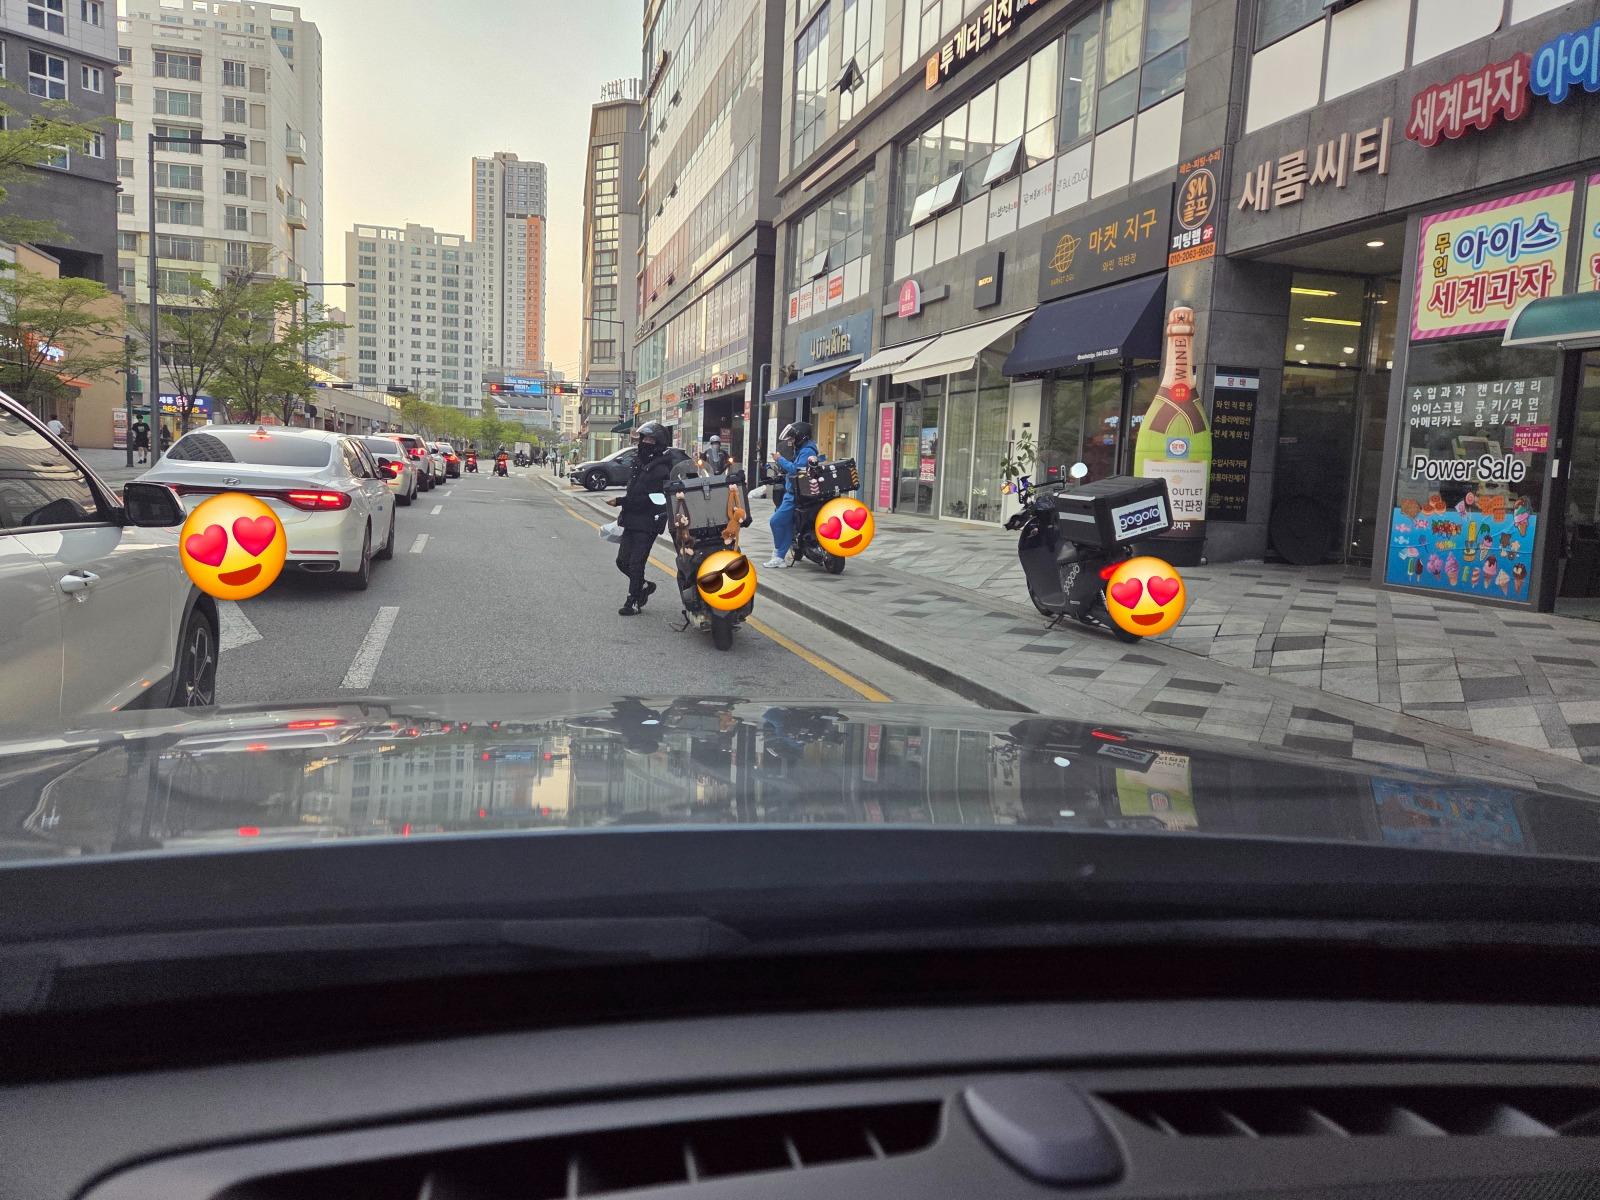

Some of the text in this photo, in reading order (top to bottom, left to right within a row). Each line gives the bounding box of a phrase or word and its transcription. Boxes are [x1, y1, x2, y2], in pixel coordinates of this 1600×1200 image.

[1410, 58, 1524, 140] 세계과자
[1237, 116, 1393, 213] 새롬씨티
[1184, 197, 1208, 222] 골프
[1088, 208, 1157, 254] 마켓 지구
[1172, 228, 1214, 249] 피팅랩 2F
[1455, 215, 1559, 267] 아이스
[1103, 259, 1114, 272] 와인
[1433, 233, 1450, 278] 무인
[1429, 264, 1553, 315] 세계과자
[1174, 338, 1187, 381] WINE
[1413, 384, 1466, 400] 수입과자
[1410, 412, 1538, 428] 아메리카노 음료/커피
[1411, 401, 1464, 415] 아이스크림
[1412, 454, 1526, 482] Power Sale
[1171, 487, 1203, 496] OUTLET
[1119, 507, 1160, 530] gogoro
[1172, 500, 1203, 513] 직판장
